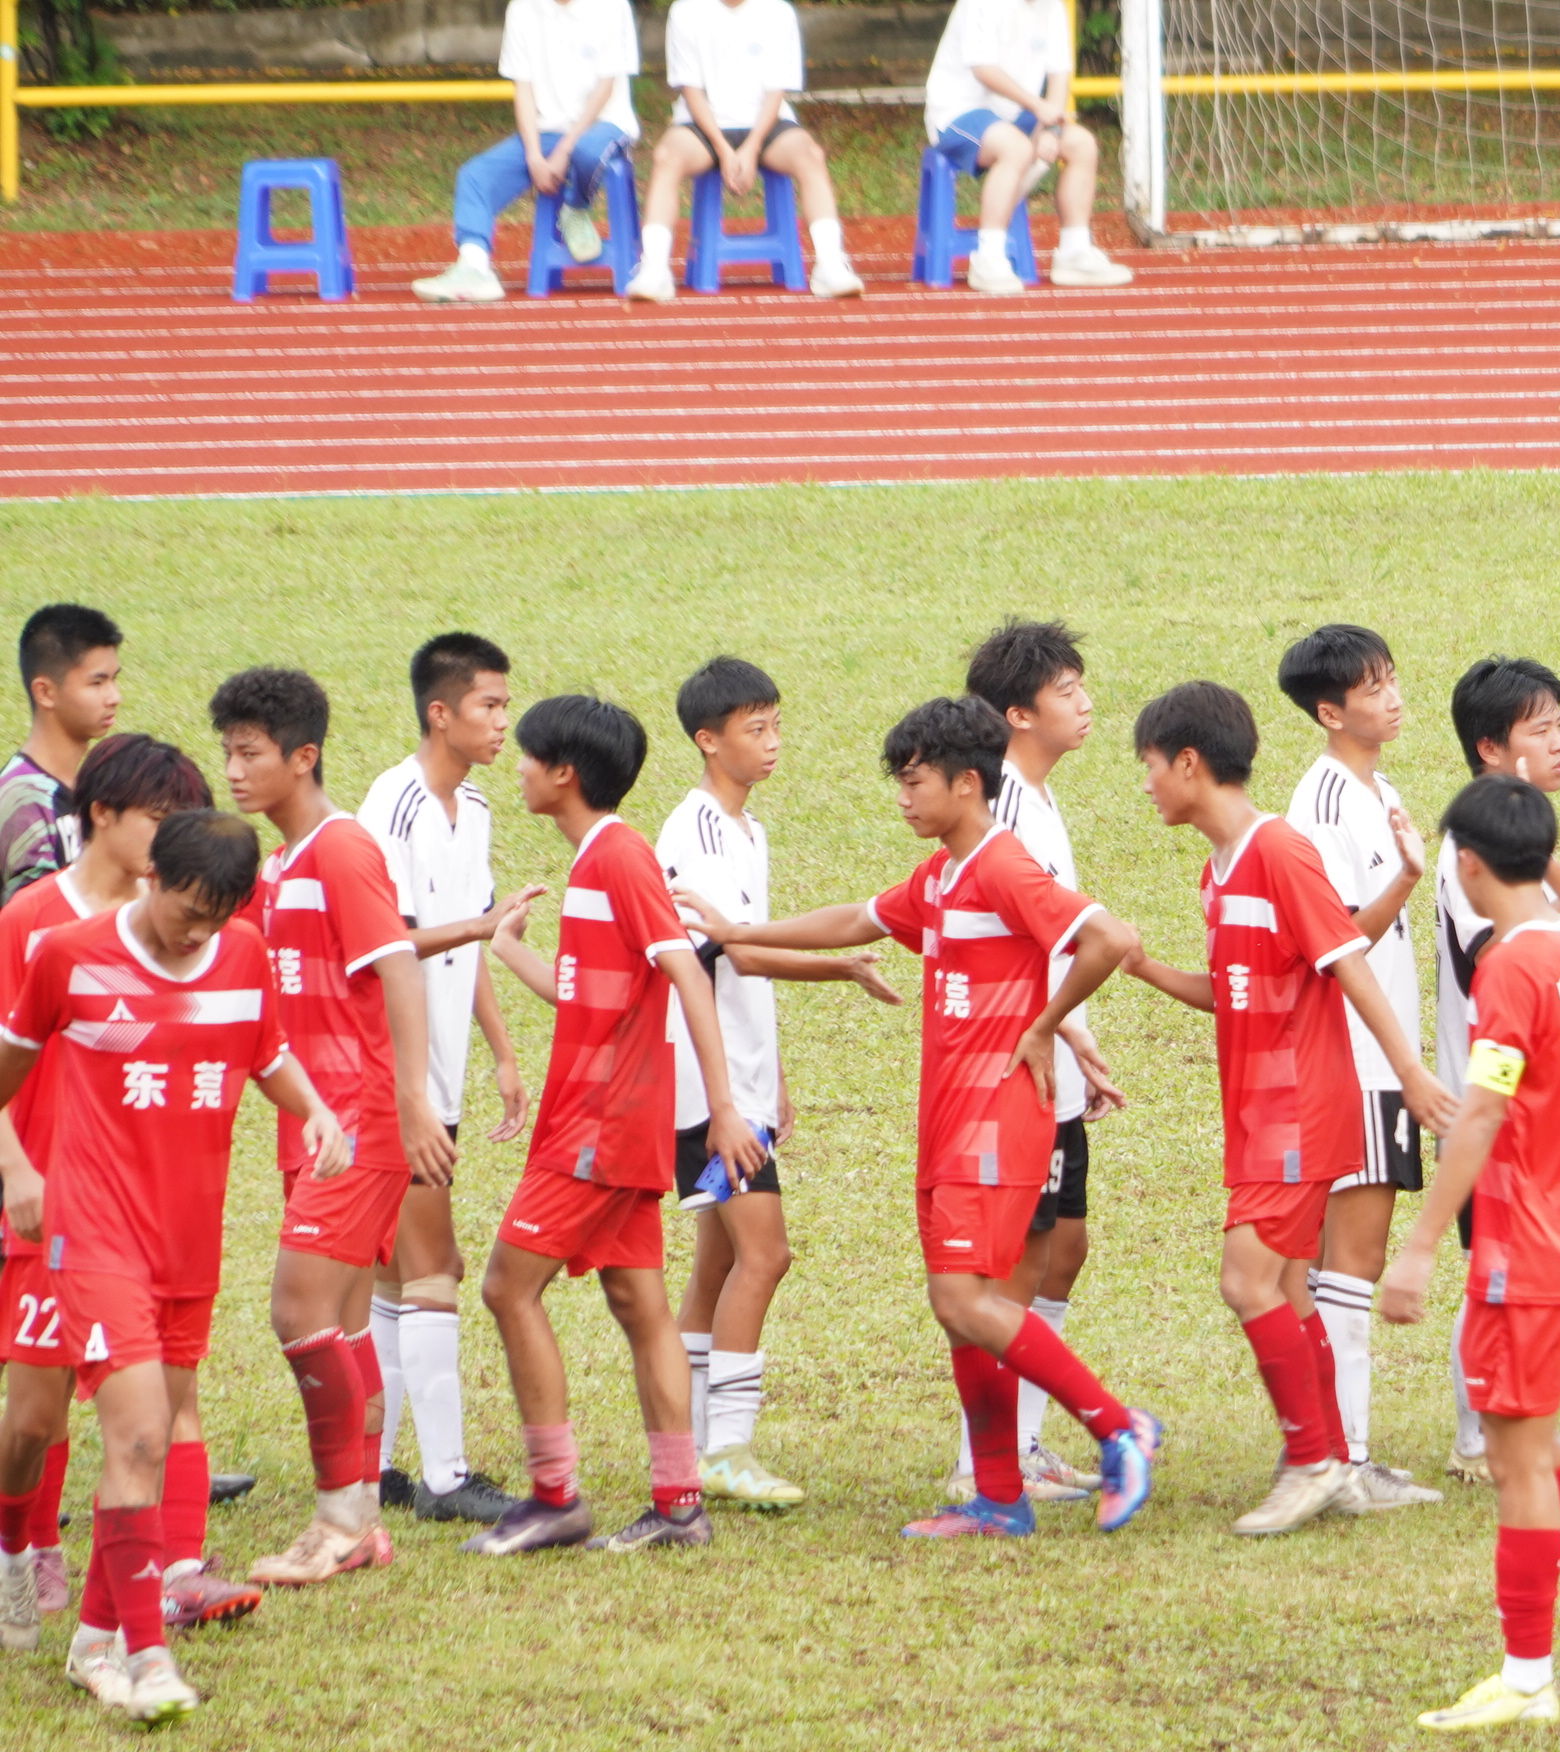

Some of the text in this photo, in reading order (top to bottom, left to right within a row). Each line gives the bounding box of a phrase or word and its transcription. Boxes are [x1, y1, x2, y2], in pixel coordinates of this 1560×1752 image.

[935, 968, 970, 1018] 莞
[122, 1060, 227, 1110] 东莞
[1394, 1108, 1409, 1152] 4
[1040, 1149, 1064, 1194] 9
[14, 1293, 59, 1348] 22
[84, 1321, 109, 1362] 4
